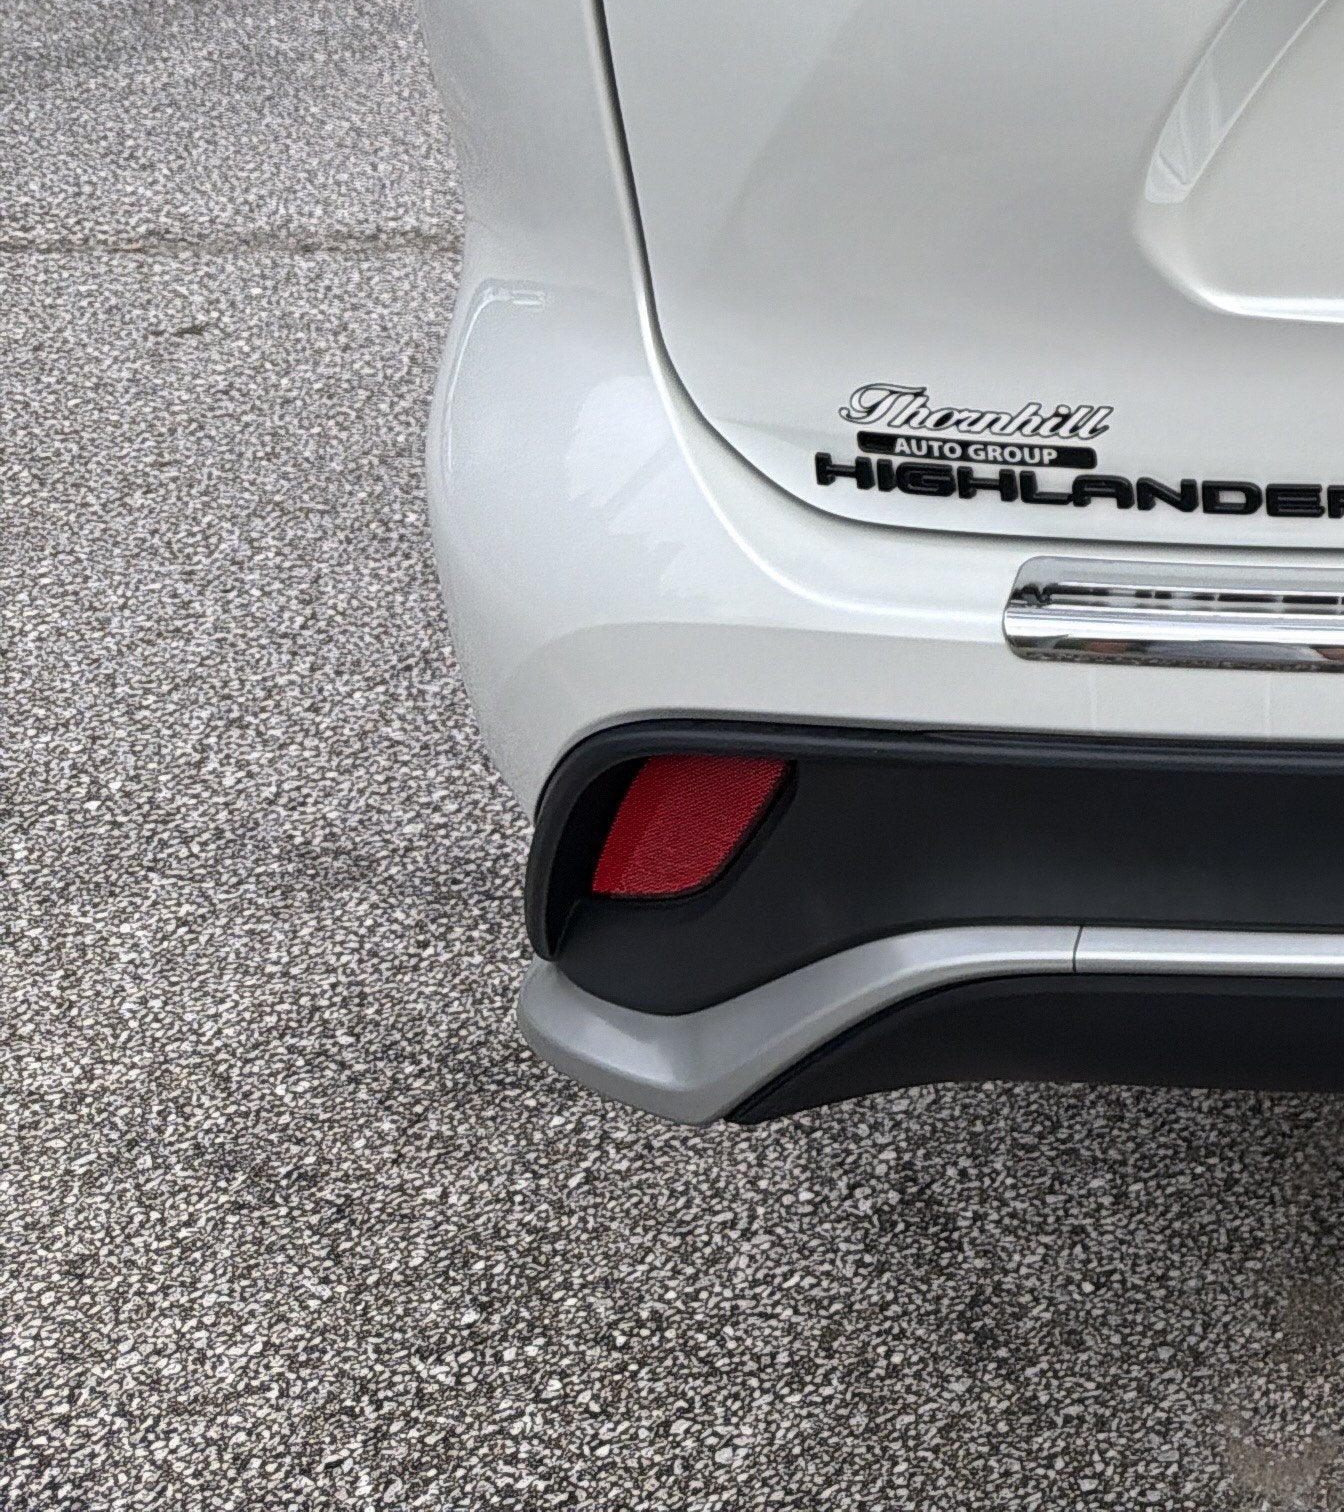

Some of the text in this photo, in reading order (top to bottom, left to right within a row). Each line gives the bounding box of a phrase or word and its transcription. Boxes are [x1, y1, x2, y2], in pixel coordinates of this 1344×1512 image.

[839, 383, 1114, 440] Thornhill
[894, 437, 1058, 465] AUTO GROUP
